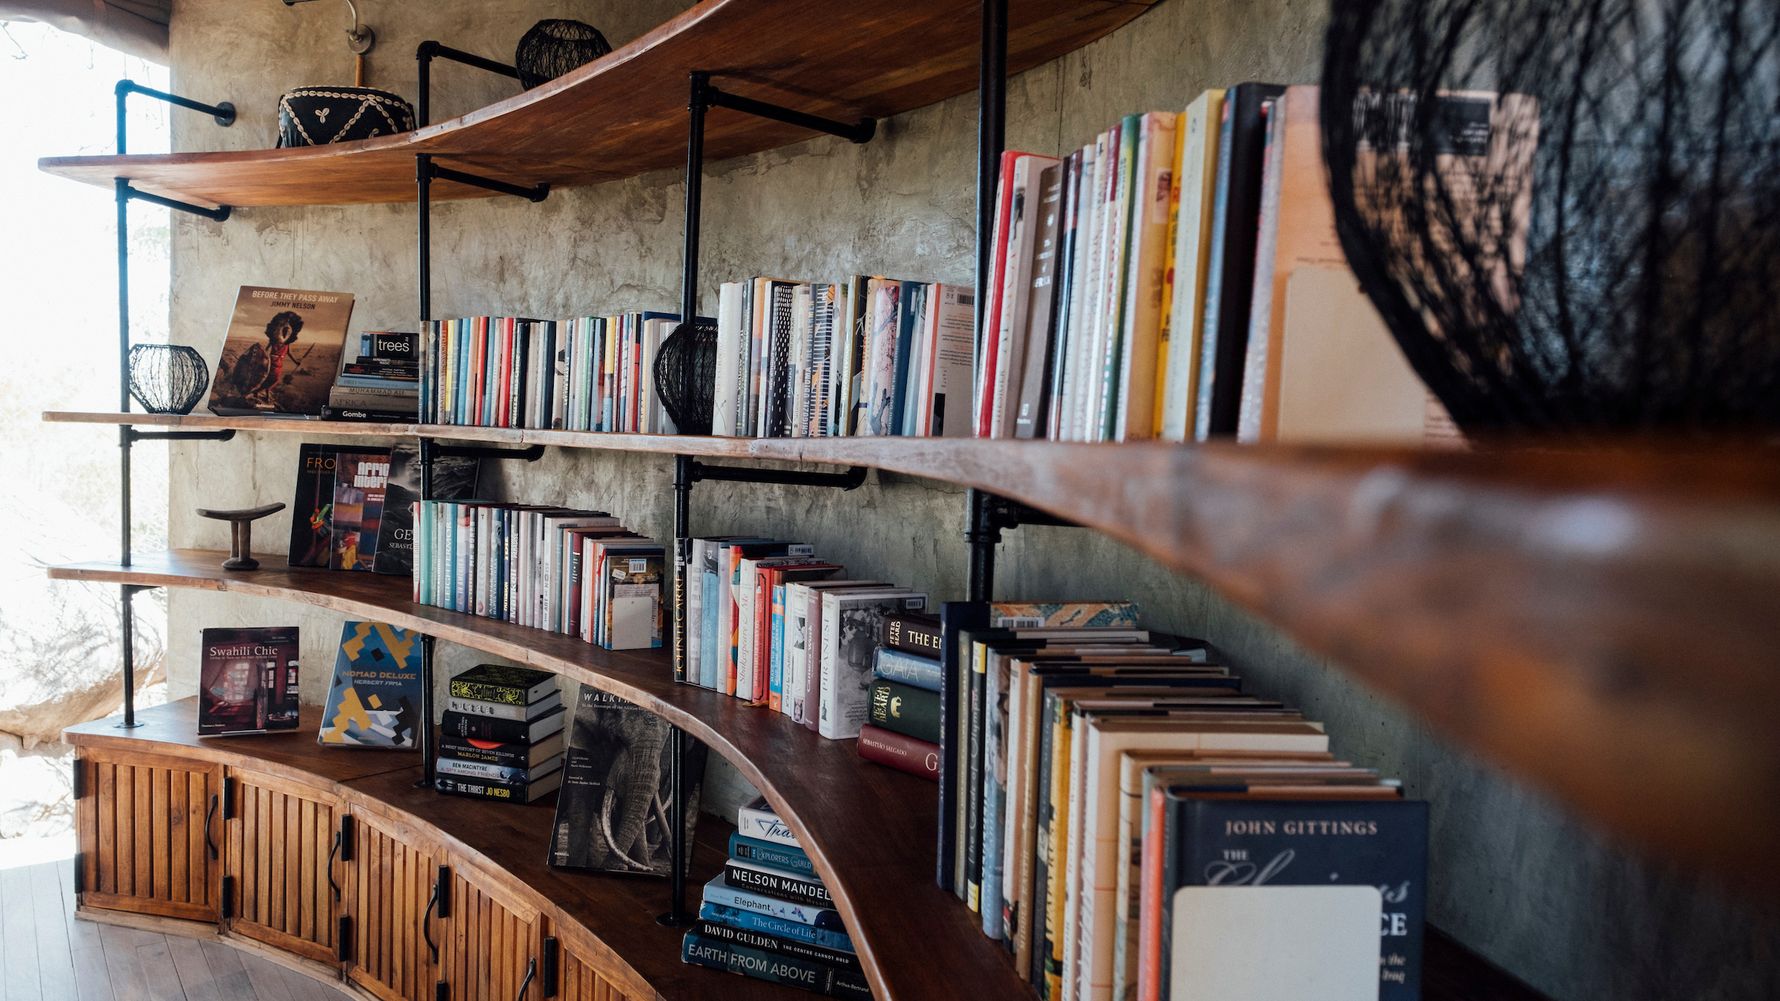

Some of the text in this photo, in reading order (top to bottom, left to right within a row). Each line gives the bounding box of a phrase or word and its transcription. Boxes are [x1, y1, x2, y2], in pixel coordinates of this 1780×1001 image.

[252, 290, 278, 299] BEFORE
[292, 302, 316, 310] NELSON
[378, 338, 410, 352] trees
[342, 410, 367, 418] Gombe
[889, 621, 897, 645] PETER
[894, 621, 902, 646] BEARD
[908, 630, 931, 647] THE
[210, 646, 278, 656] Swahili Chic
[739, 626, 748, 684] Shakespeare
[379, 672, 417, 680] DELUXE
[880, 653, 919, 682] GAIA
[584, 693, 629, 703] WALKI
[873, 686, 884, 721] PETER
[879, 687, 890, 723] BEARD
[969, 686, 980, 759] Olympus
[457, 751, 480, 759] MARLON
[886, 744, 908, 756] SALGADO
[462, 763, 488, 771] MACINTYRE
[457, 783, 467, 793] THE
[467, 784, 484, 795] THIRST
[485, 786, 494, 796] JO
[1225, 820, 1378, 837] JOHN GITTINGS
[757, 847, 789, 864] EXPLORERS
[967, 836, 976, 864] The
[1223, 850, 1248, 861] THE
[732, 869, 834, 901] NELSON MANDEL
[741, 883, 788, 898] Conversations
[789, 892, 804, 901] with
[734, 896, 771, 912] Elephant
[1019, 848, 1030, 952] MIDDLE EARTH
[752, 916, 817, 939] The Circle of Life
[704, 924, 779, 950] DAVID GULDEN
[688, 943, 728, 963] EARTH
[730, 952, 767, 973] FROM
[770, 963, 817, 984] ABOVE
[793, 946, 813, 956] CENTRE
[814, 952, 834, 961] CANNOT
[835, 956, 850, 964] HOLD
[1387, 952, 1405, 967] the
